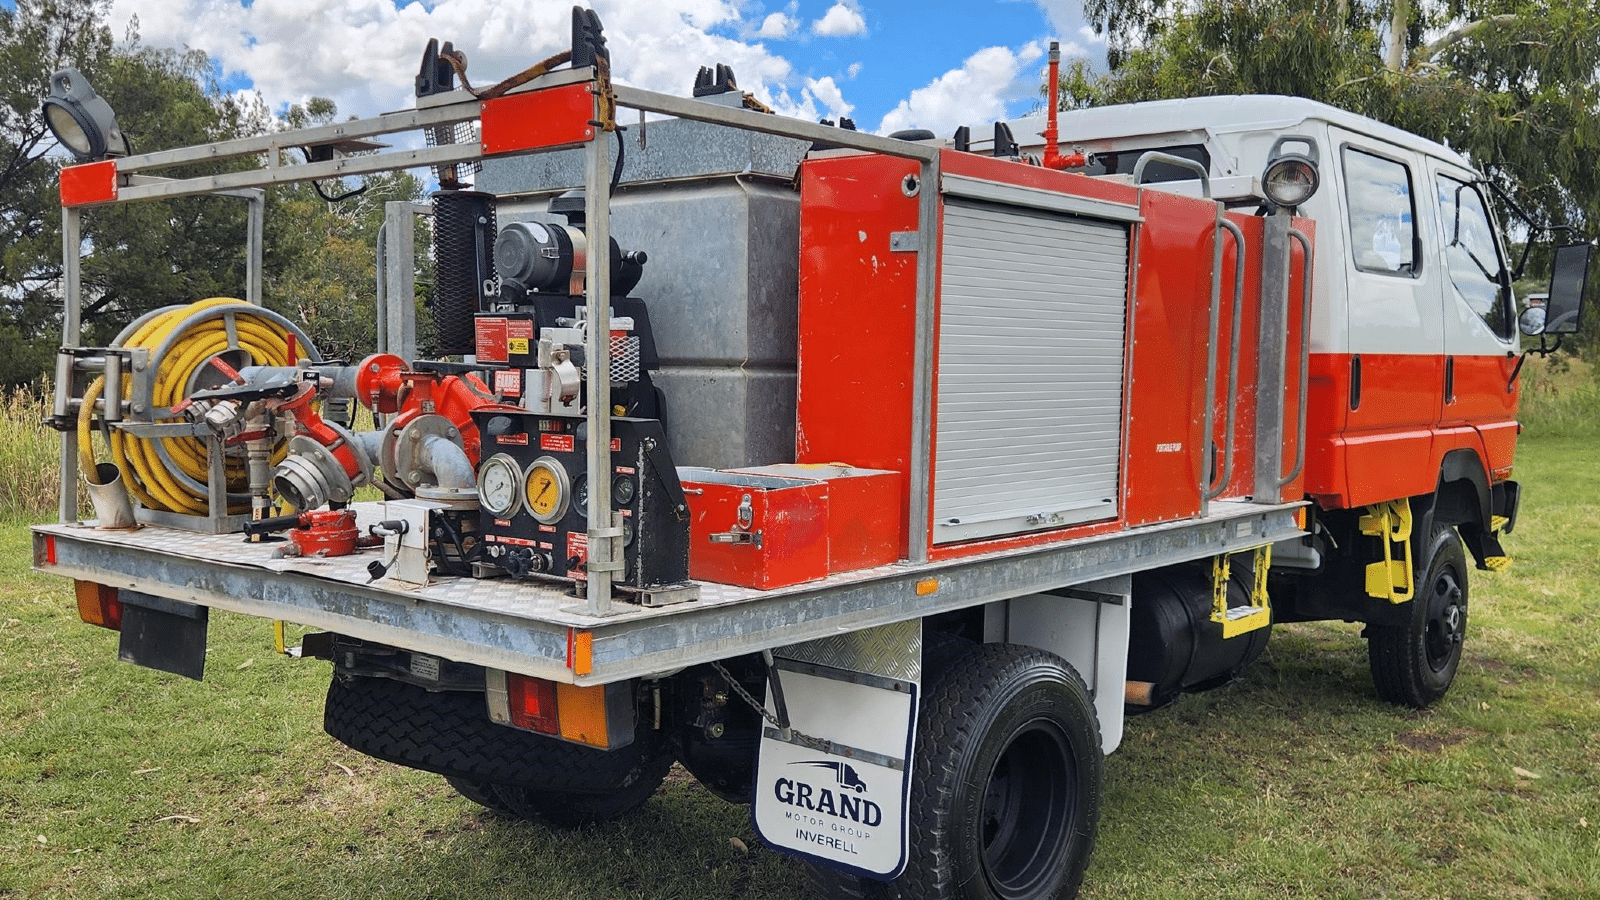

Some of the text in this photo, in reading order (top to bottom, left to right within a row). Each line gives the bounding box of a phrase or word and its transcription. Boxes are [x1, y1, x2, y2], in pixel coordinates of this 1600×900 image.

[774, 777, 882, 827] GRAND
[785, 811, 870, 839] MOTOR GROUP
[795, 828, 858, 855] INVERELL
